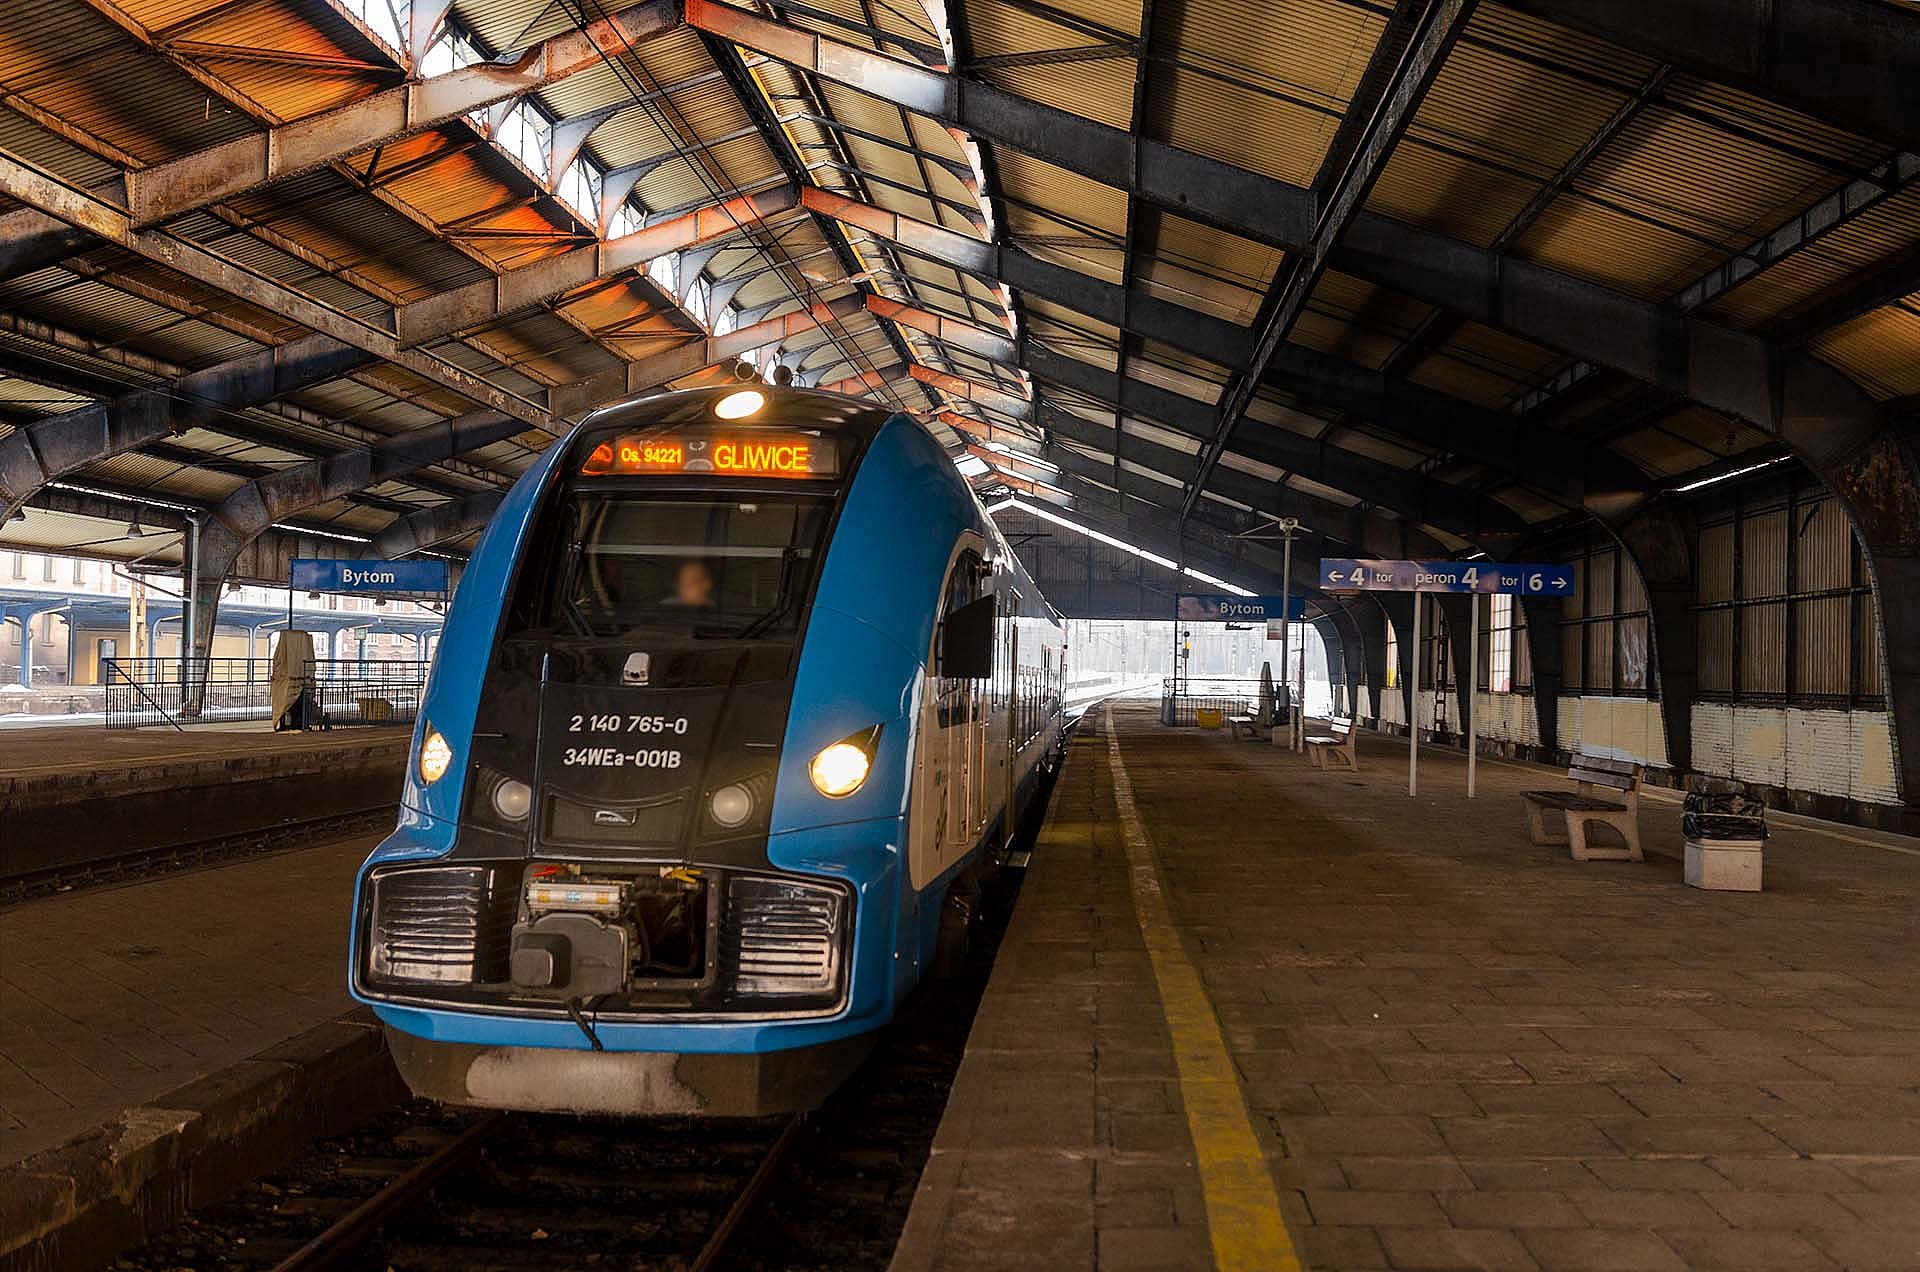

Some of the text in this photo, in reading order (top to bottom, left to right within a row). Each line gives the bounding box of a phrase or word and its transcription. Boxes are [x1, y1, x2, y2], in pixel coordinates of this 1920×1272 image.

[621, 445, 809, 471] Os. 94221 GLIWICE
[343, 568, 395, 586] Bytom
[1350, 567, 1544, 592] 4 tor peron 4 tor 6
[1220, 602, 1265, 615] Bytom
[568, 714, 688, 735] 2 140 765-0
[563, 747, 682, 769] 34WEa-001B
